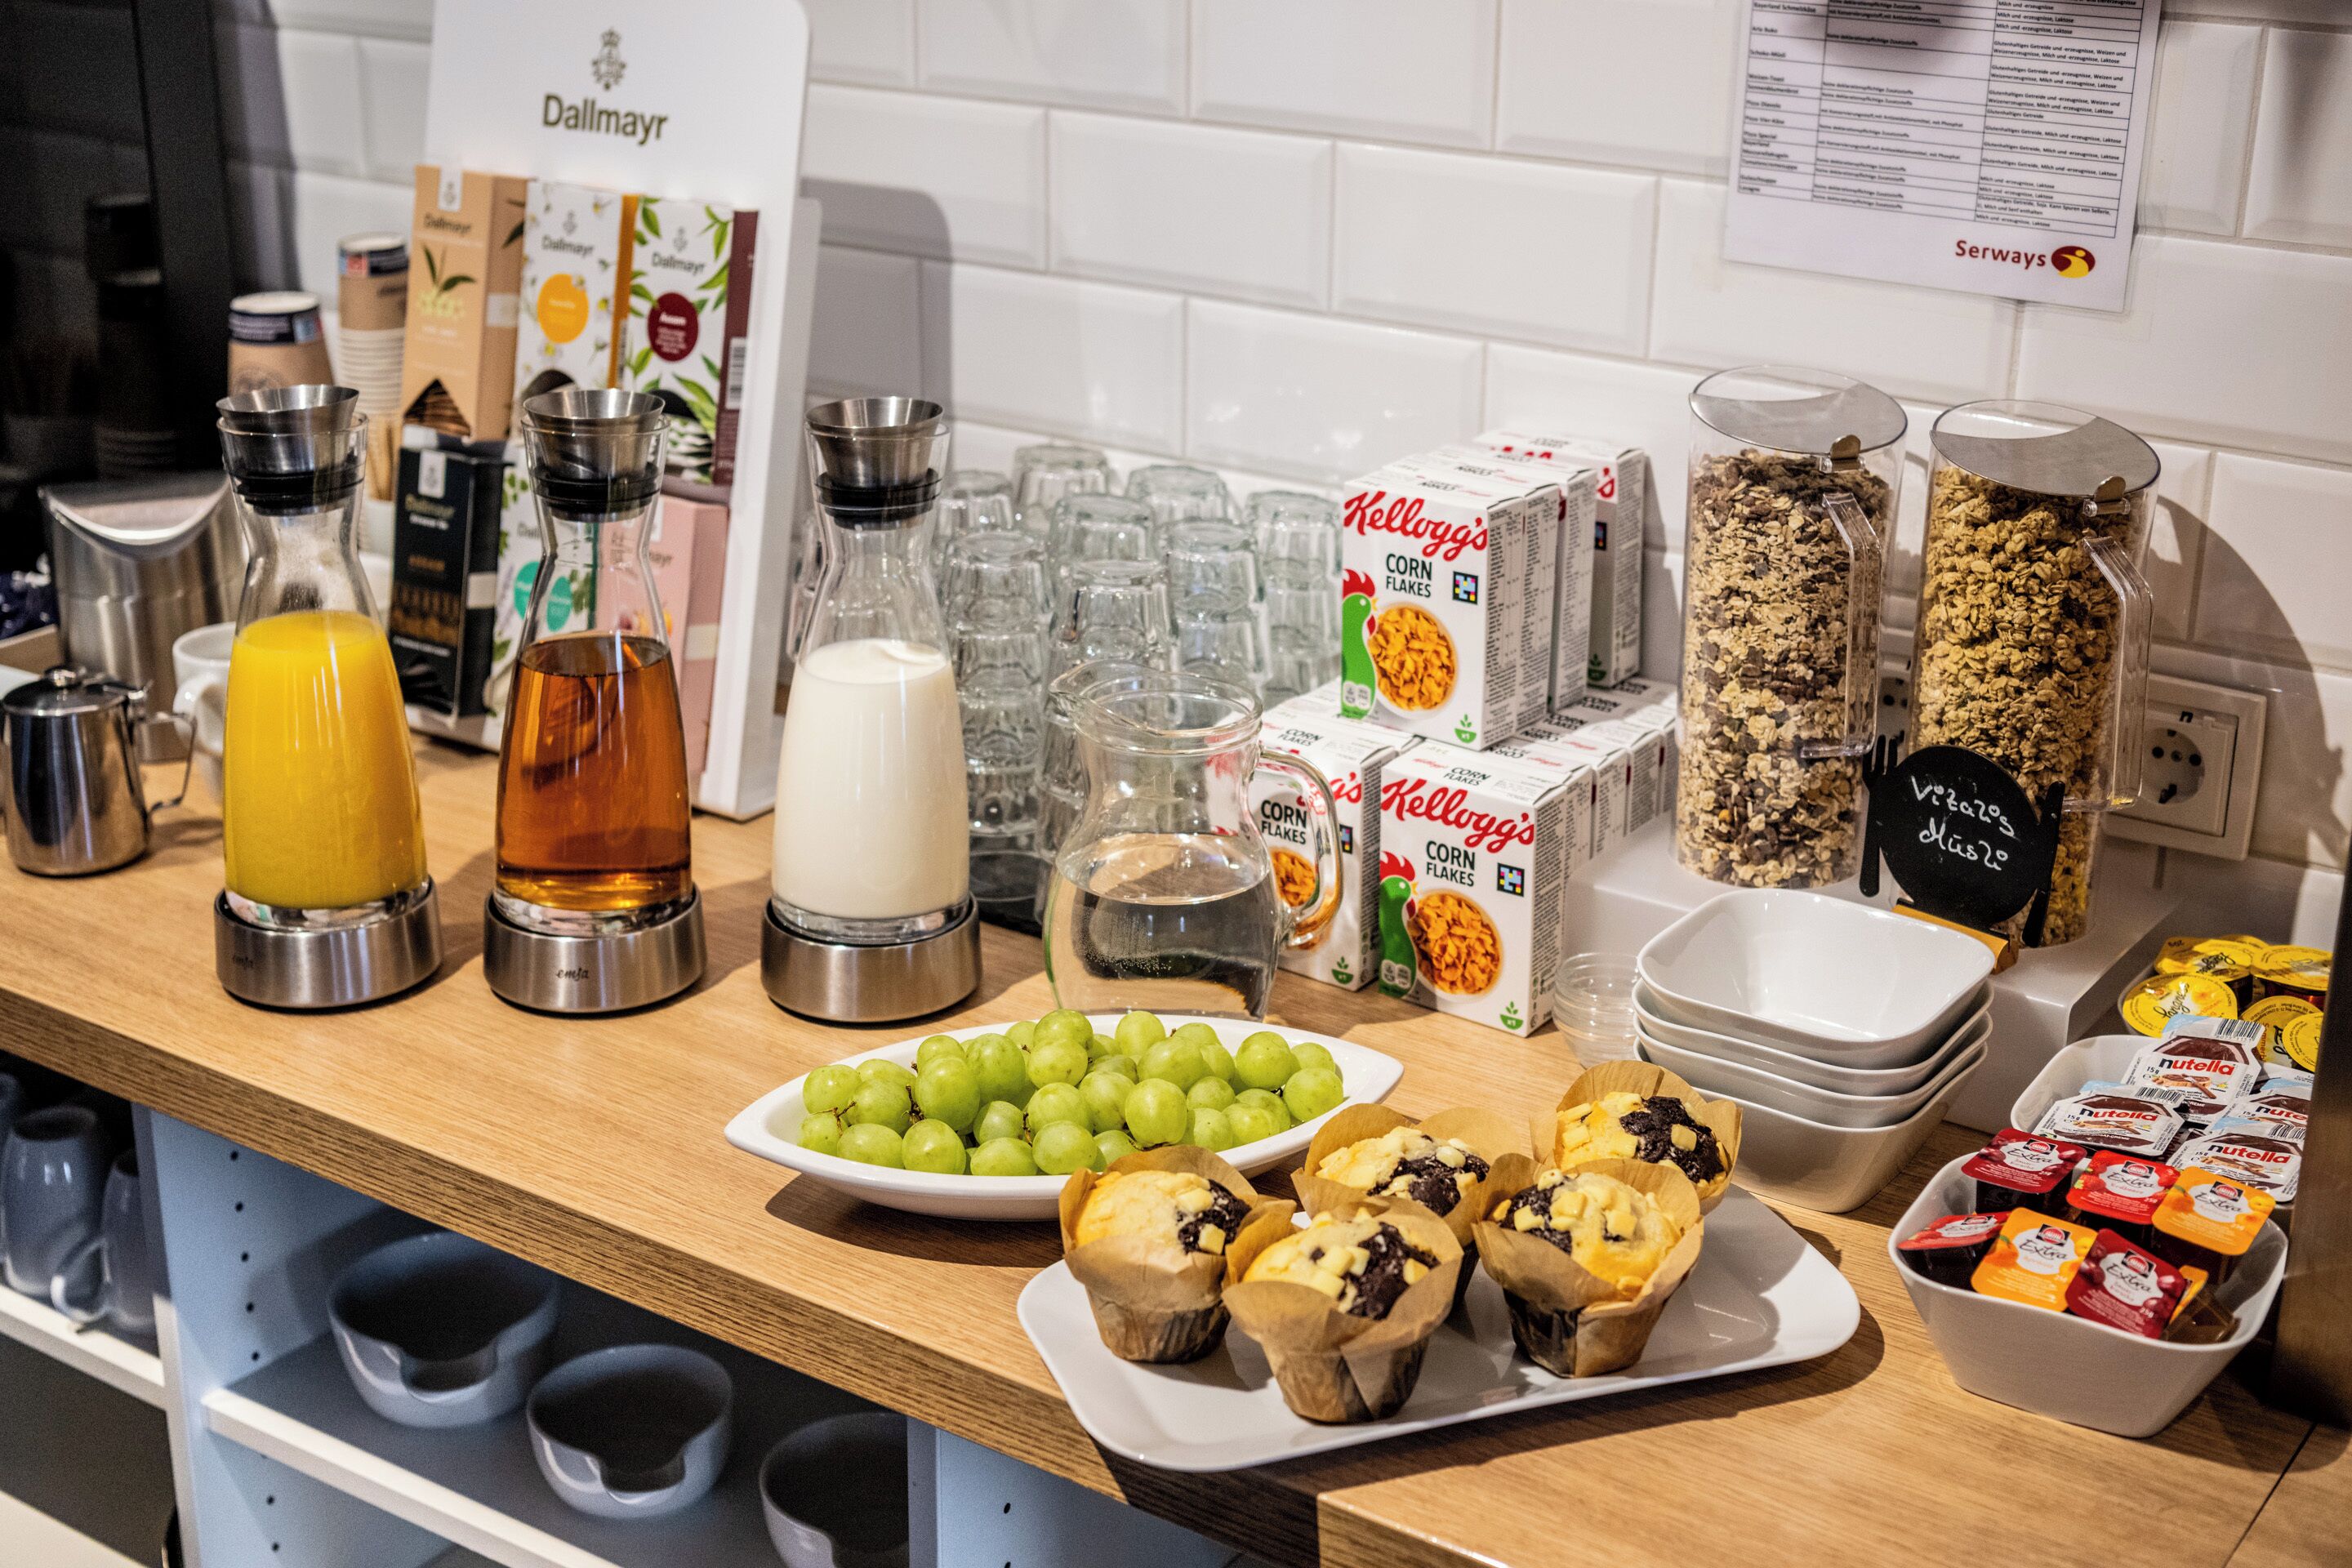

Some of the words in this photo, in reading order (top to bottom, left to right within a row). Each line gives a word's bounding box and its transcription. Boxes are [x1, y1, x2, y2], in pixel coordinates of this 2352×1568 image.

[543, 95, 668, 145] Dallmayr
[541, 235, 594, 257] Dallmayr
[1955, 240, 2046, 270] Serways
[652, 252, 705, 276] Dallmayr
[1343, 491, 1487, 561] Kellogg's
[1386, 554, 1432, 581] CORN
[1386, 577, 1431, 598] FLAKES
[1278, 734, 1312, 746] FLAKES
[1285, 728, 1324, 742] CORN
[1444, 773, 1481, 786] FLAKES
[1450, 767, 1491, 780] CORN
[1261, 799, 1307, 828] CORN
[1380, 778, 1535, 853] Kellogg's
[1261, 821, 1307, 844] FLAKES
[1426, 840, 1476, 871] CORN
[1426, 862, 1475, 887] FLAKES
[2158, 1058, 2235, 1076] nutella
[2079, 1108, 2158, 1121] nutella
[2256, 1106, 2309, 1120] nute
[2007, 1148, 2052, 1164] Extra
[2207, 1144, 2290, 1164] nutella
[2107, 1172, 2154, 1188] Extra
[2195, 1192, 2242, 1212] Extra
[2020, 1239, 2068, 1260] Extra
[2106, 1263, 2151, 1292] Extra
[2139, 1307, 2154, 1318] 25g
